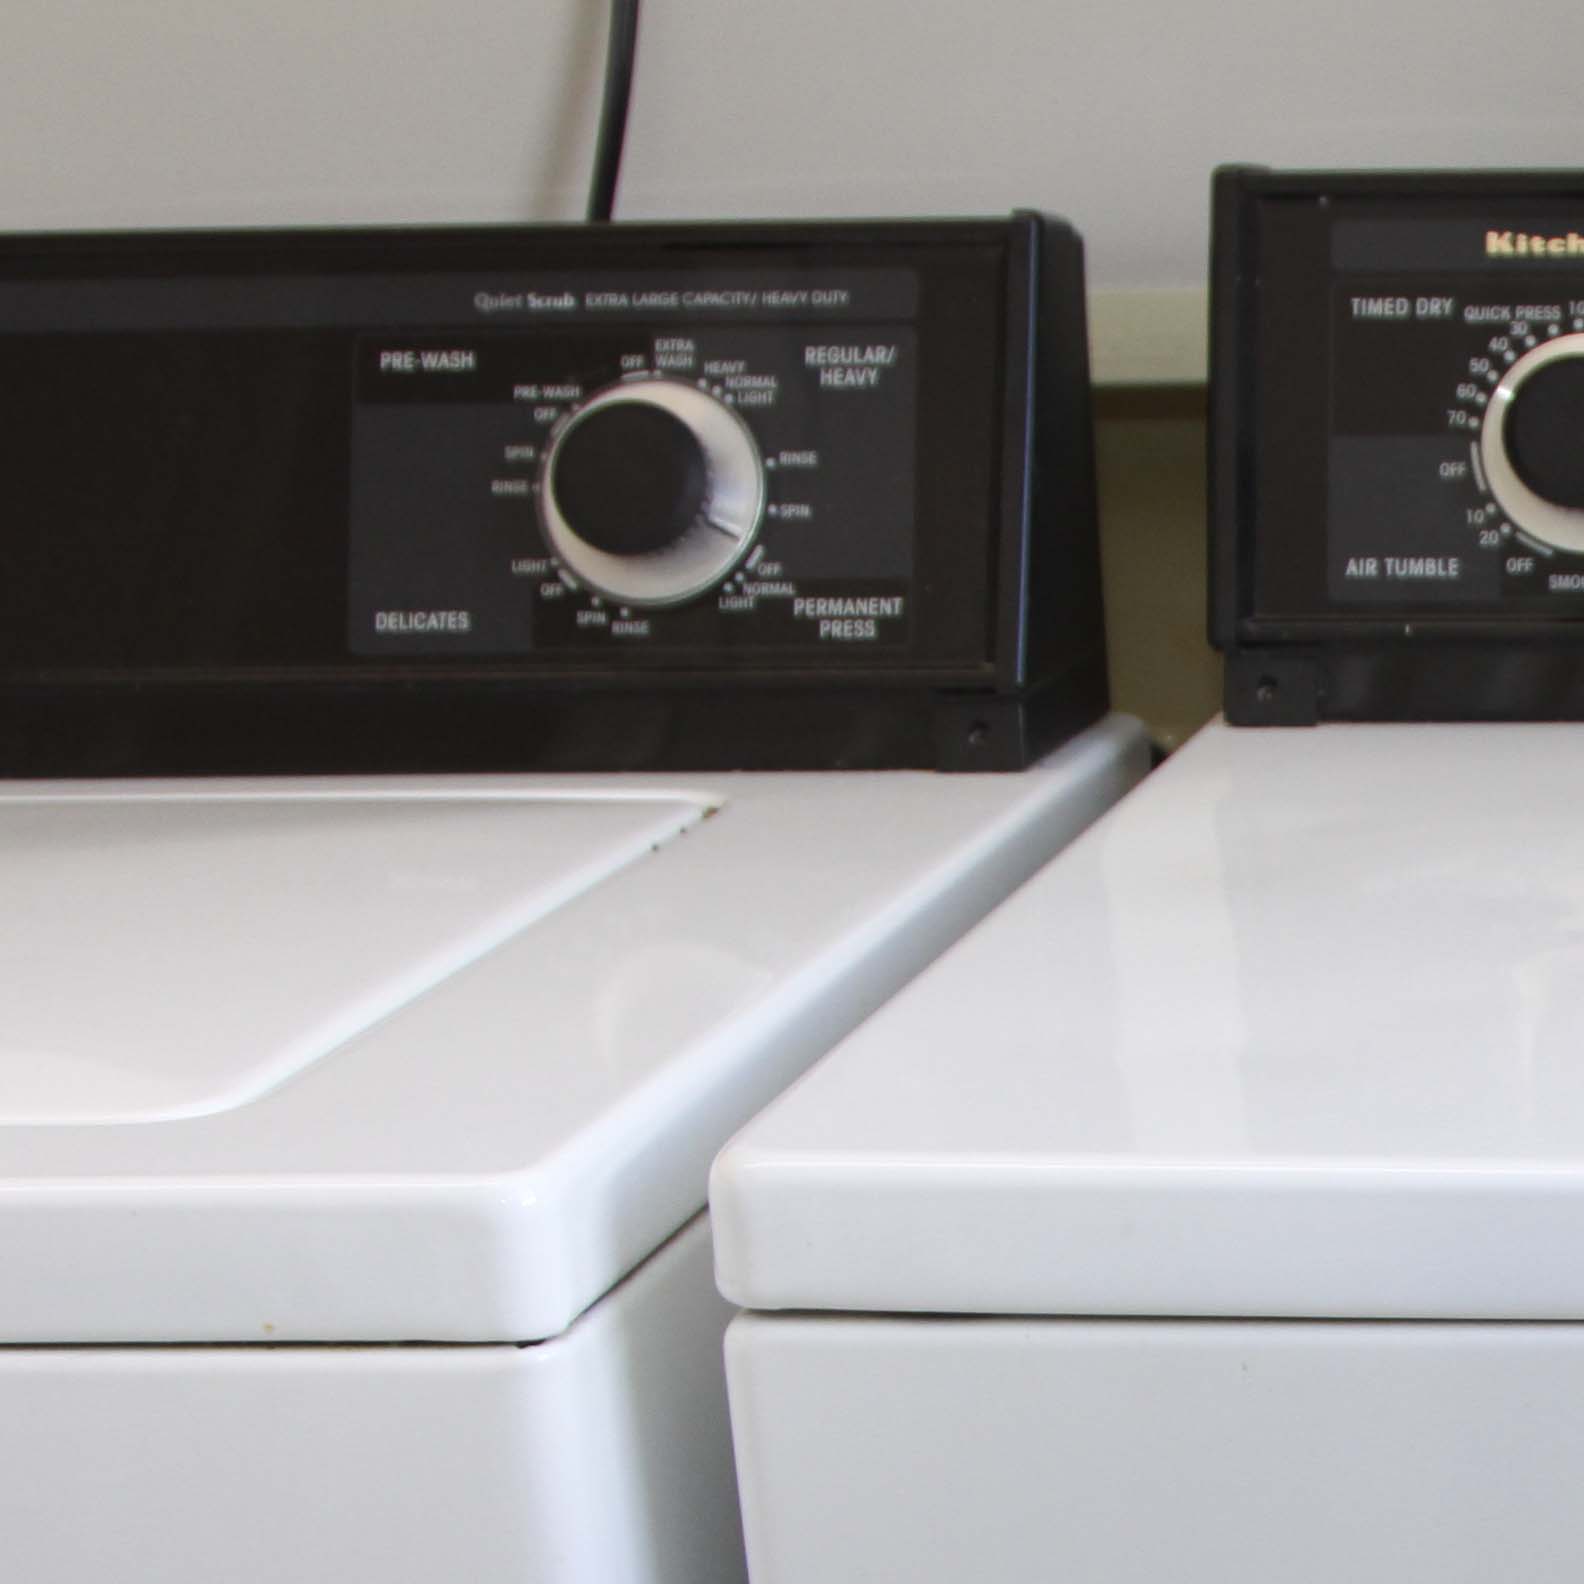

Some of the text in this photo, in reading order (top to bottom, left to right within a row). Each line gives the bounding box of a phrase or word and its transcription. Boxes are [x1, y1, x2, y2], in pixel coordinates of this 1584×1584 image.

[474, 291, 577, 314] Quiet Scrub
[585, 293, 628, 308] EXTRA
[632, 293, 679, 308] LARGE
[762, 291, 808, 306] HEAVY
[812, 290, 848, 305] DUTY
[1351, 298, 1455, 316] TIMED DRY
[1464, 305, 1562, 321] QUICK PRESS
[1510, 321, 1529, 336] 30
[655, 338, 695, 352] EXTRA
[1489, 337, 1509, 351] 40
[379, 351, 476, 371] PRE-WASH
[620, 355, 646, 369] OFF
[655, 353, 694, 368] WASH
[804, 346, 896, 366] REGULAR/
[704, 361, 746, 375] HEAVY
[1469, 358, 1490, 373] 50
[726, 376, 778, 389] NORMAL
[820, 368, 879, 388] HEAVY
[513, 383, 582, 399] PRE-WASH
[737, 391, 775, 405] LIGHT
[1456, 384, 1476, 399] 60
[533, 407, 558, 422] OFF
[1447, 411, 1467, 425] 70
[504, 445, 535, 461] SPIN
[780, 451, 818, 466] RINSE
[1439, 462, 1466, 478] OFF
[491, 479, 529, 496] RINSE
[780, 503, 812, 519] SPIN
[1466, 510, 1485, 525] 10
[1480, 530, 1499, 546] 20
[511, 558, 548, 574] LIGHT
[758, 563, 782, 577] OFF
[1345, 557, 1459, 577] AIR TUMBLE
[1506, 557, 1535, 574] OFF
[540, 582, 564, 598] OFF
[743, 581, 796, 595] NORMAL
[718, 597, 756, 610] LIGHT
[793, 597, 904, 617] PERMANENT
[375, 610, 470, 632] DELICATES
[577, 610, 607, 626] SPIN
[612, 620, 649, 636] RINSE
[819, 619, 878, 639] PRESS
